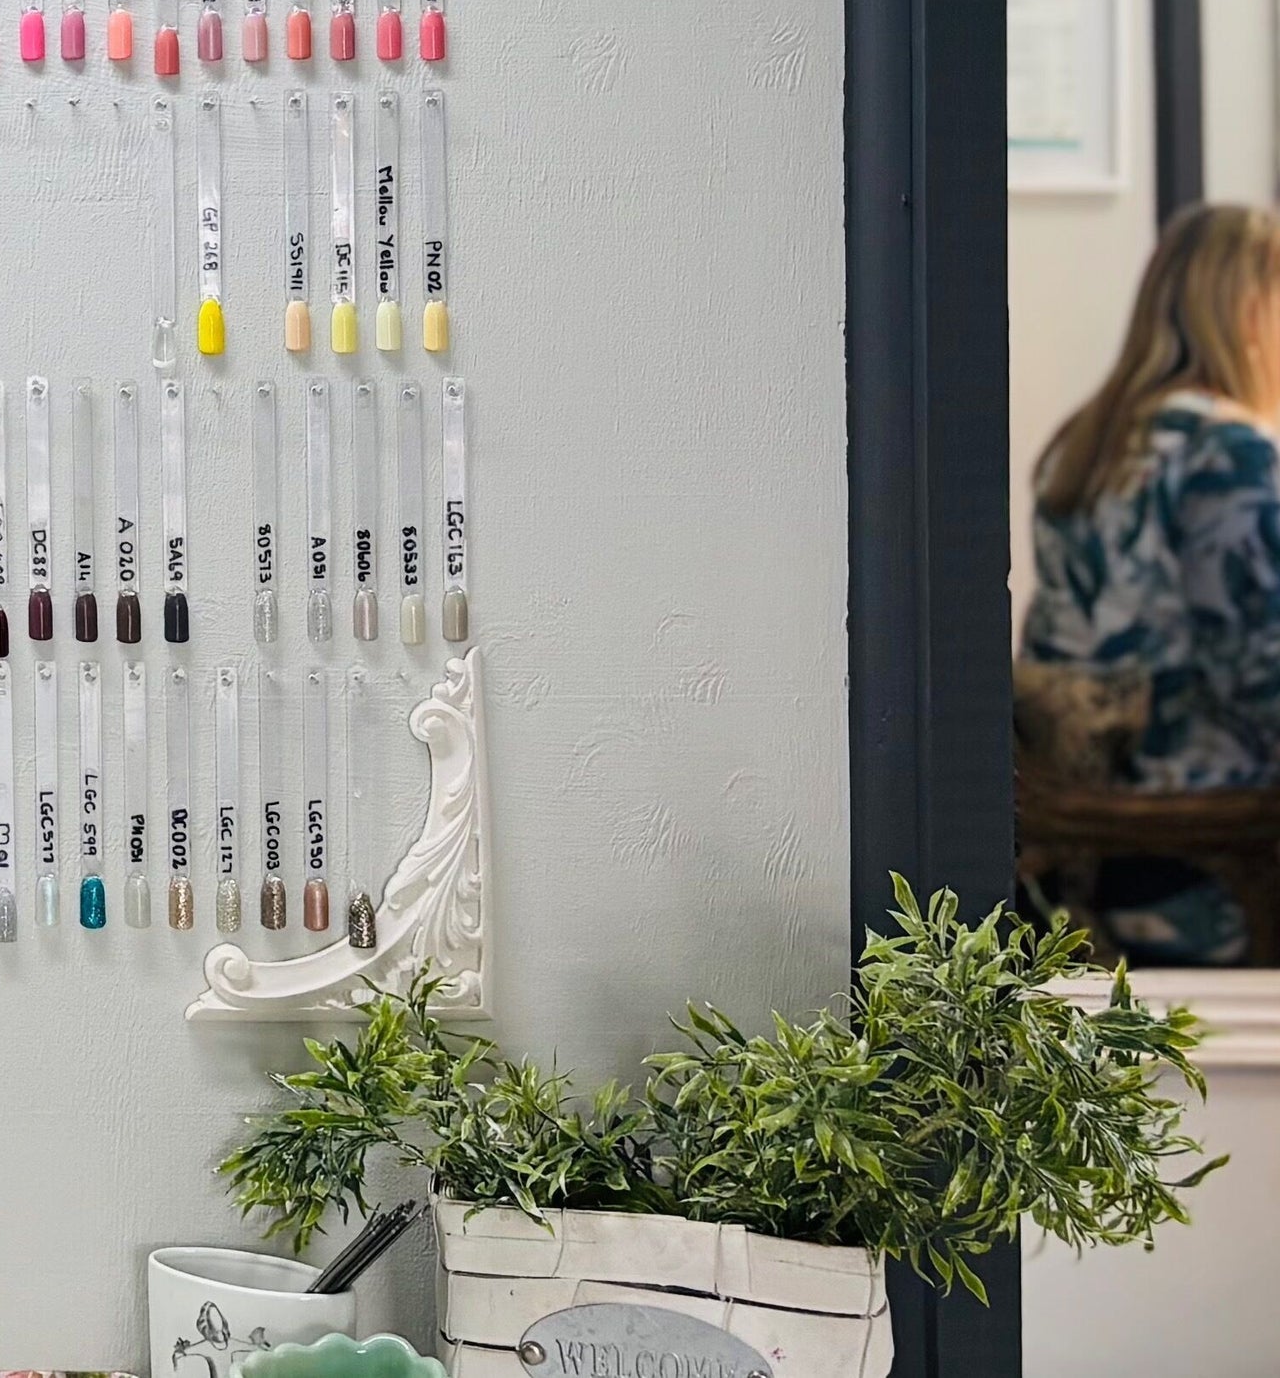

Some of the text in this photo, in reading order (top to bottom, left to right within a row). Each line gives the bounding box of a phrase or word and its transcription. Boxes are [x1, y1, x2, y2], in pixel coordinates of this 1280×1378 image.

[379, 233, 394, 295] Yellow
[31, 529, 47, 578] DC88
[76, 551, 92, 581] A14
[257, 523, 272, 584] 80573
[402, 525, 418, 586] 80533
[446, 500, 464, 576] LGC163
[39, 790, 54, 864] LGC577
[264, 800, 280, 870] LGC003
